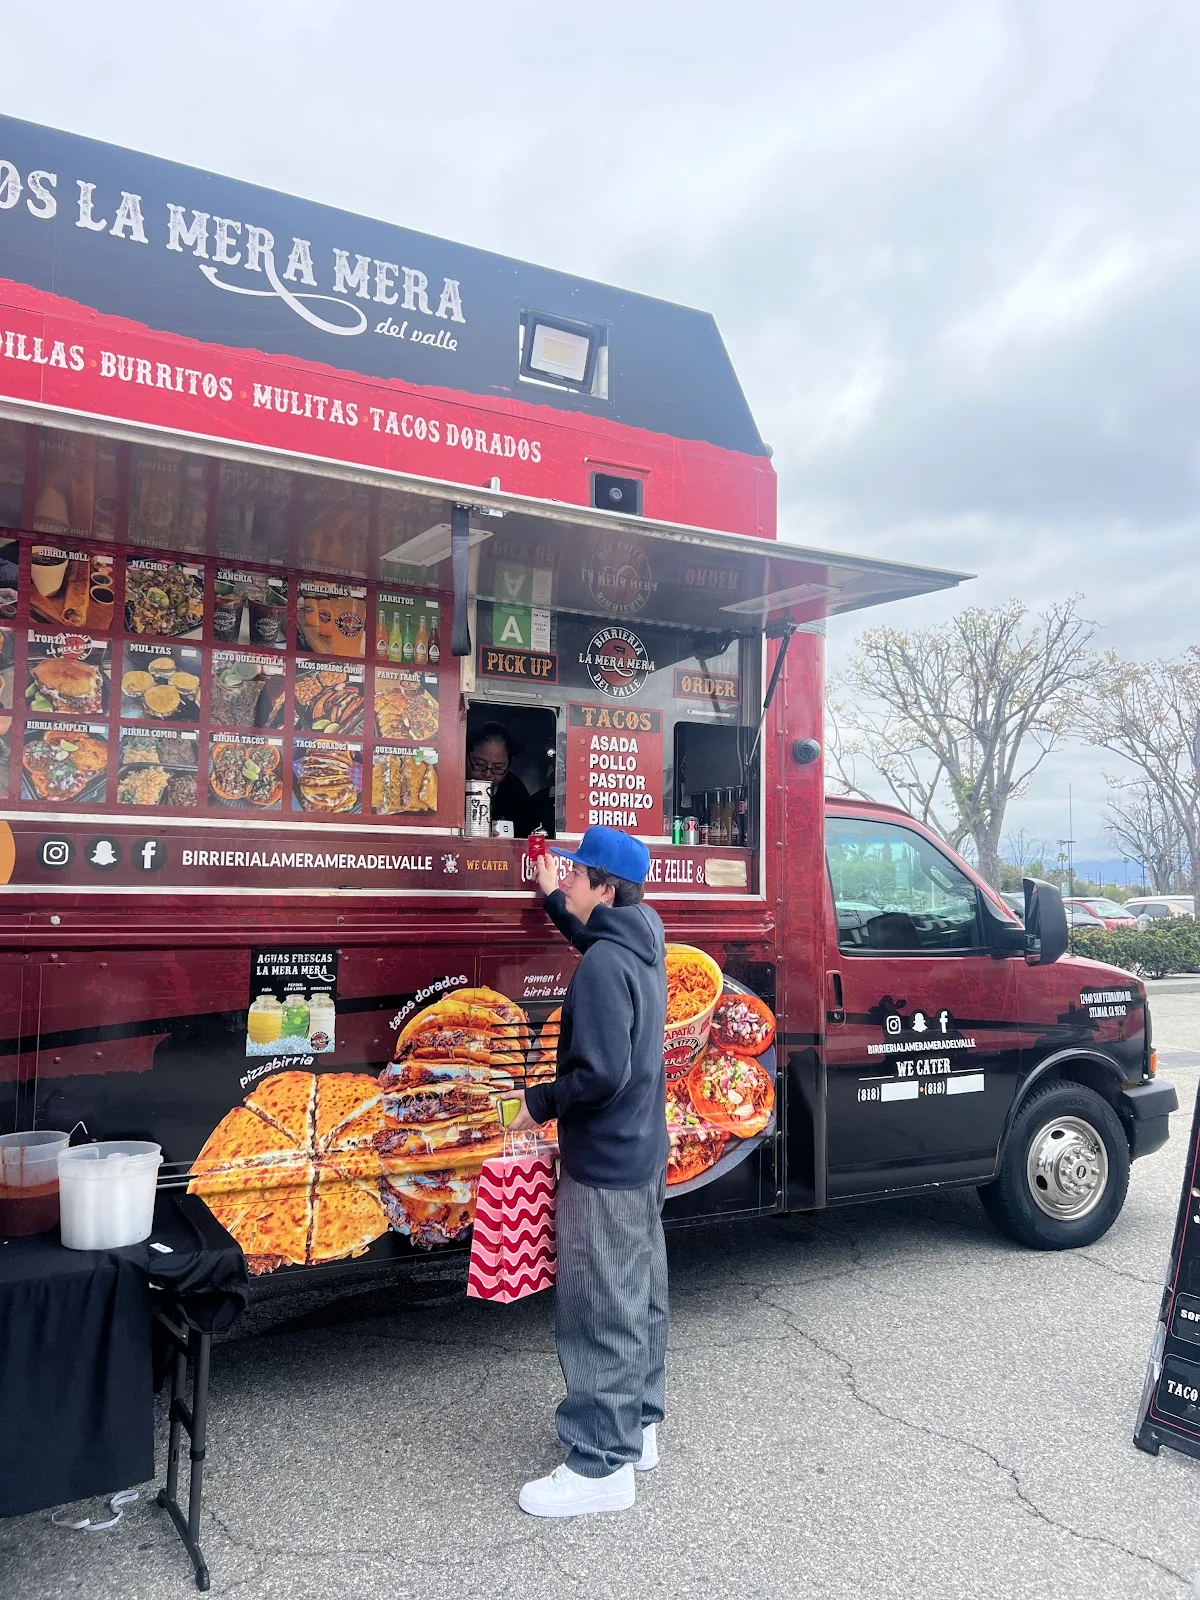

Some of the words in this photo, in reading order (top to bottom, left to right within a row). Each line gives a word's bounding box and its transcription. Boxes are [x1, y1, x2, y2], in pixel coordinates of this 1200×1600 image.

[76, 179, 149, 244] LA
[166, 202, 357, 326] MERA
[332, 247, 466, 324] MERA
[374, 316, 406, 340] del
[410, 326, 458, 352] valle
[0, 331, 85, 371] ILLAS
[100, 351, 233, 401] BURRITOS
[252, 383, 358, 427] MULITAS
[369, 406, 440, 443] TACOS
[446, 423, 542, 463] DORADOS
[39, 548, 67, 559] BIRRIA
[68, 551, 90, 562] ROLL
[132, 560, 168, 572] NACHOS
[217, 571, 252, 584] SANGRIA
[300, 583, 348, 597] MICHELADAS
[379, 593, 415, 606] JARRITOS
[500, 615, 524, 644] A
[35, 634, 66, 645] TORTA
[596, 629, 643, 656] BIRRIERIA
[130, 643, 172, 655] MULITAS
[214, 652, 234, 661] KETO
[235, 654, 284, 666] QUESADILLA
[297, 660, 315, 670] TACOS
[316, 662, 343, 673] DORADOS
[487, 652, 526, 675] PICK
[531, 656, 553, 677] UP
[579, 652, 592, 665] LA
[594, 655, 629, 675] MERA
[627, 659, 655, 672] MERA
[377, 671, 398, 680] PARTY
[592, 673, 609, 692] DEL
[612, 679, 641, 697] VALLE
[681, 679, 736, 698] ORDER
[26, 721, 52, 730] BIRRIA
[52, 722, 88, 733] SAMPLER
[582, 706, 652, 731] TACOS
[122, 728, 150, 737] BIRRIA
[151, 730, 177, 739] COMBO
[212, 734, 240, 744] BIRRIA
[241, 736, 265, 745] TACOS
[296, 739, 316, 749] TACOS
[317, 741, 347, 751] DORADOS
[375, 746, 418, 756] QUESADILLA
[590, 735, 638, 753] ASADA
[589, 754, 637, 771] POLLO
[589, 772, 645, 790] PASTOR
[589, 790, 653, 809] CHORIZO
[589, 809, 638, 827] BIRRIA
[182, 849, 432, 871] BIRRIERIALAMERAMERADELVALLE
[466, 860, 480, 870] WE
[481, 860, 509, 871] CATER
[665, 860, 693, 882] ZELLE
[696, 865, 704, 883] &
[257, 954, 289, 964] AGUAS
[292, 954, 333, 963] FRESCAS
[256, 966, 268, 976] LA
[271, 966, 298, 975] MERA
[523, 974, 554, 984] ramen
[523, 986, 551, 997] birria
[388, 1000, 416, 1031] tacos
[414, 974, 468, 1003] dorados
[867, 1038, 976, 1054] BIRRIERIALAMERAMERADELVALLE
[239, 1054, 315, 1089] pizzabirria
[896, 1060, 914, 1077] WE
[916, 1058, 951, 1076] CATER
[857, 1087, 880, 1102] (818)
[924, 1081, 945, 1096] (818)
[1167, 1380, 1199, 1402] TACO
